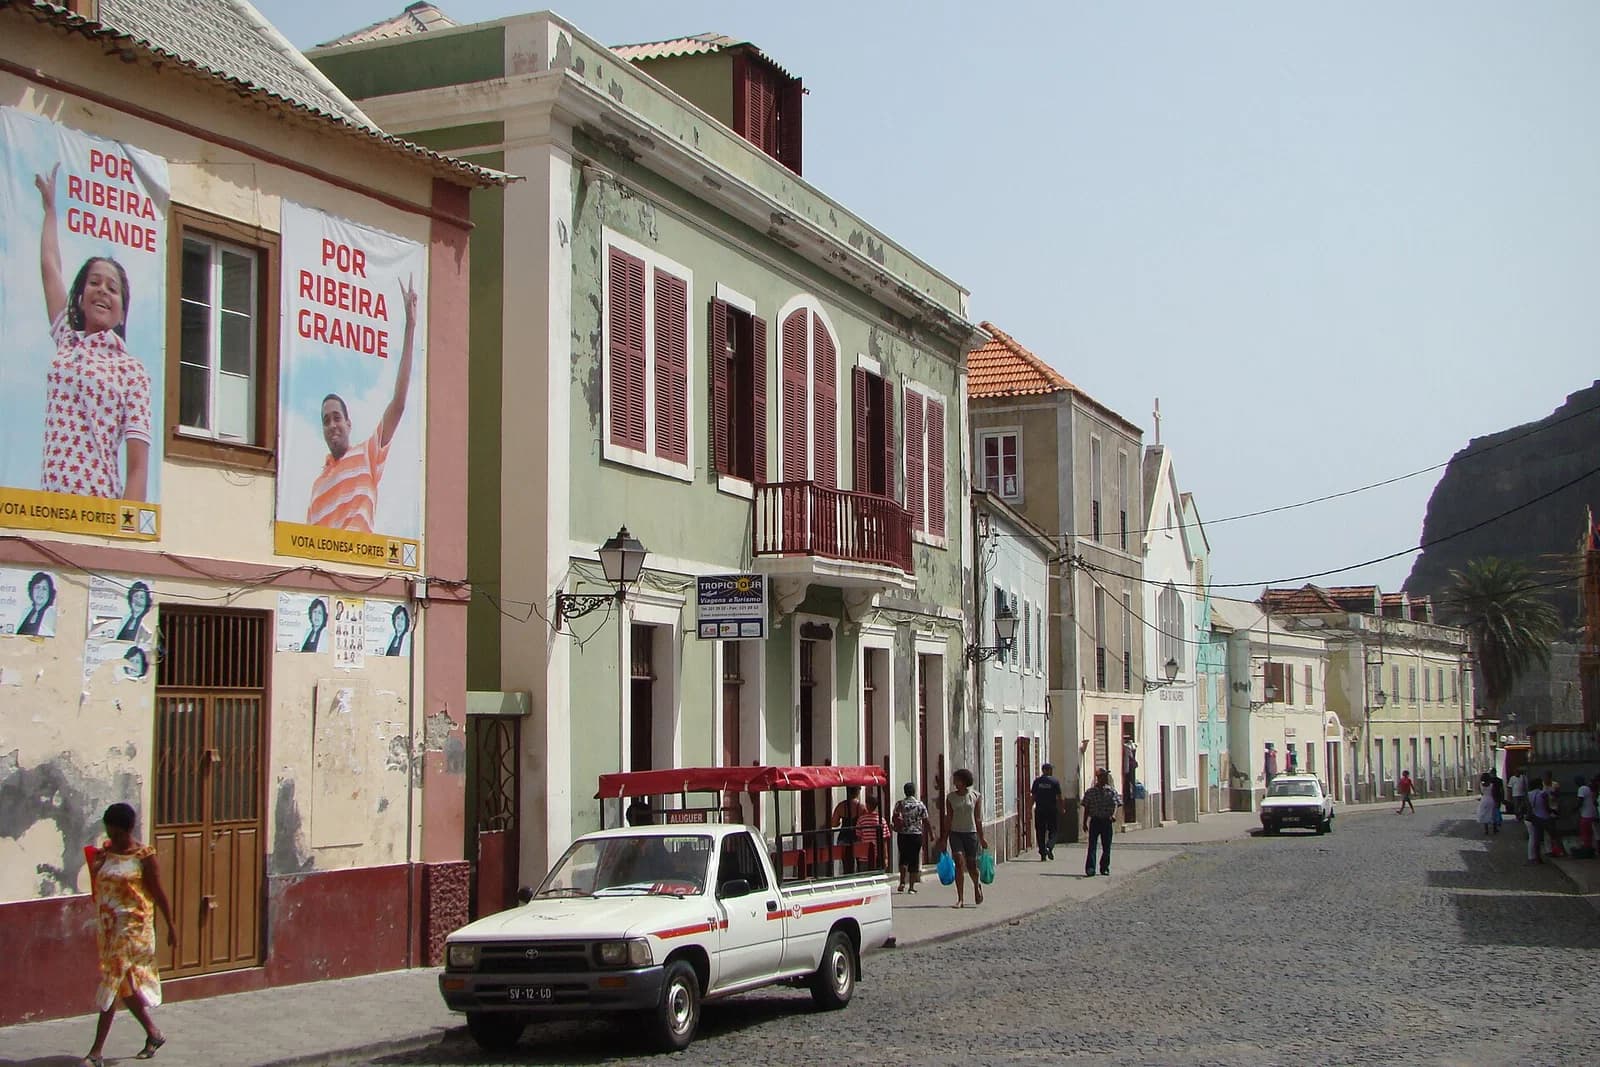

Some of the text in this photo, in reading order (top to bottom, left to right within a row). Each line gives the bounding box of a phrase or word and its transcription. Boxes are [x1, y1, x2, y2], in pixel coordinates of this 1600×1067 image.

[90, 149, 134, 184] POR
[68, 174, 156, 221] RIBEIRA
[67, 207, 156, 253] GRANDE
[322, 238, 366, 278] POR
[299, 269, 388, 321] RIBEIRA
[298, 308, 388, 359] GRANDE
[30, 505, 78, 520] LEONESA
[81, 511, 116, 525] FORTES
[291, 535, 384, 557] VOTA LEONESA FORTES
[0, 585, 17, 593] eira
[671, 813, 703, 823] ALUGUER
